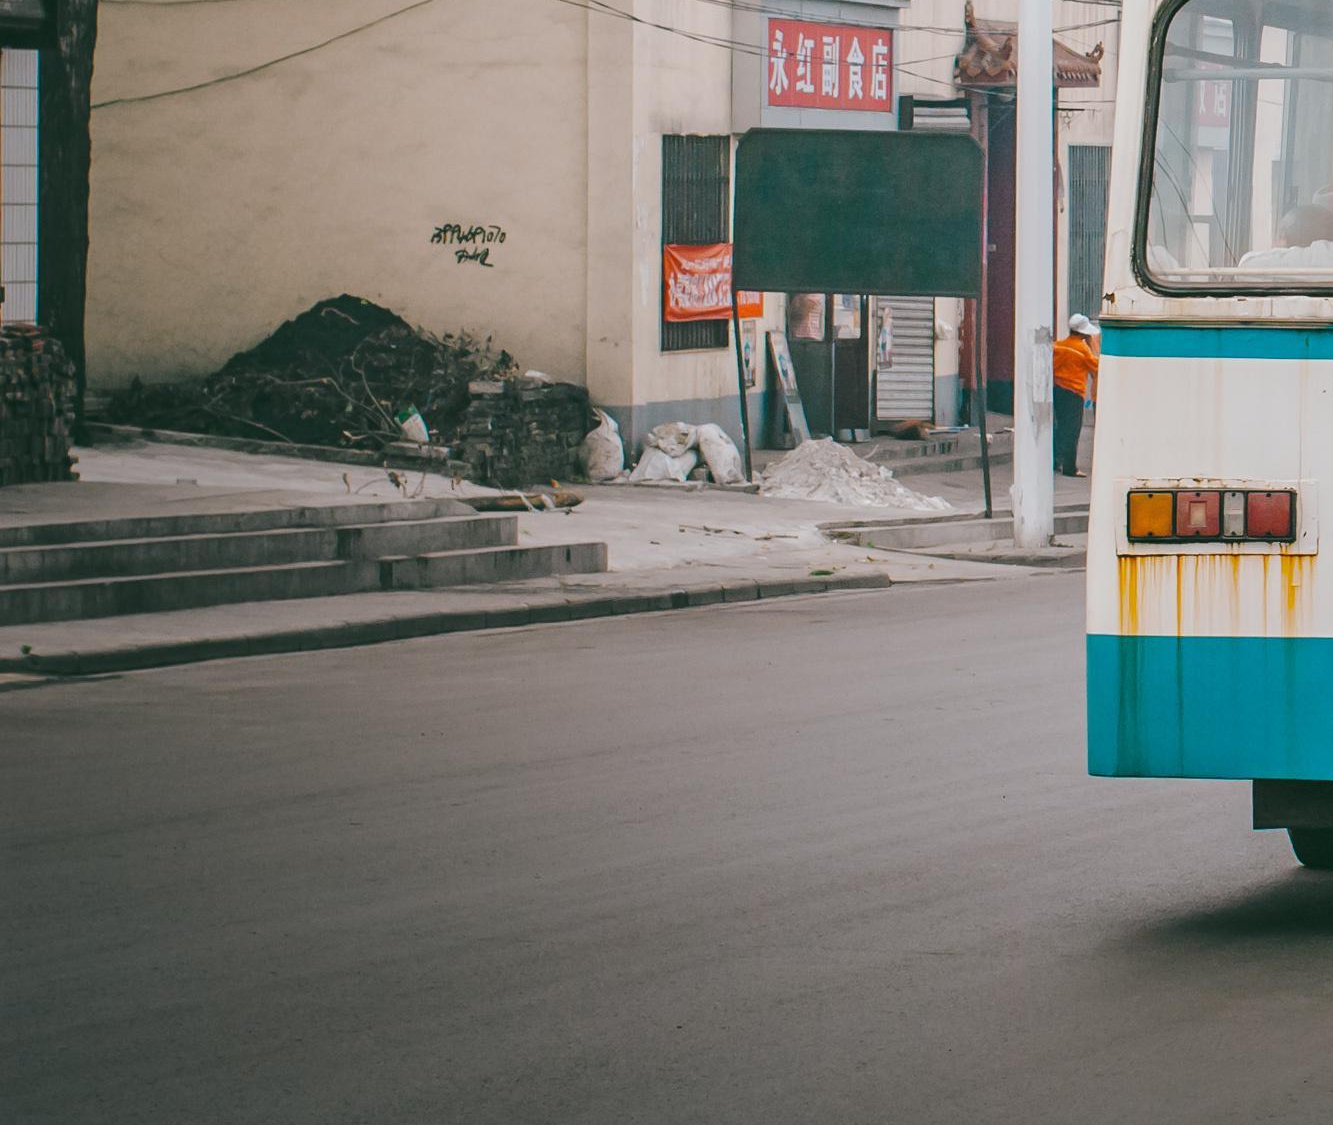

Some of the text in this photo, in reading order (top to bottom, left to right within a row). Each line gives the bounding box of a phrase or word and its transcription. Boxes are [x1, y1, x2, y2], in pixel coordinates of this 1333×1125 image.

[769, 28, 889, 100] 永红副食店
